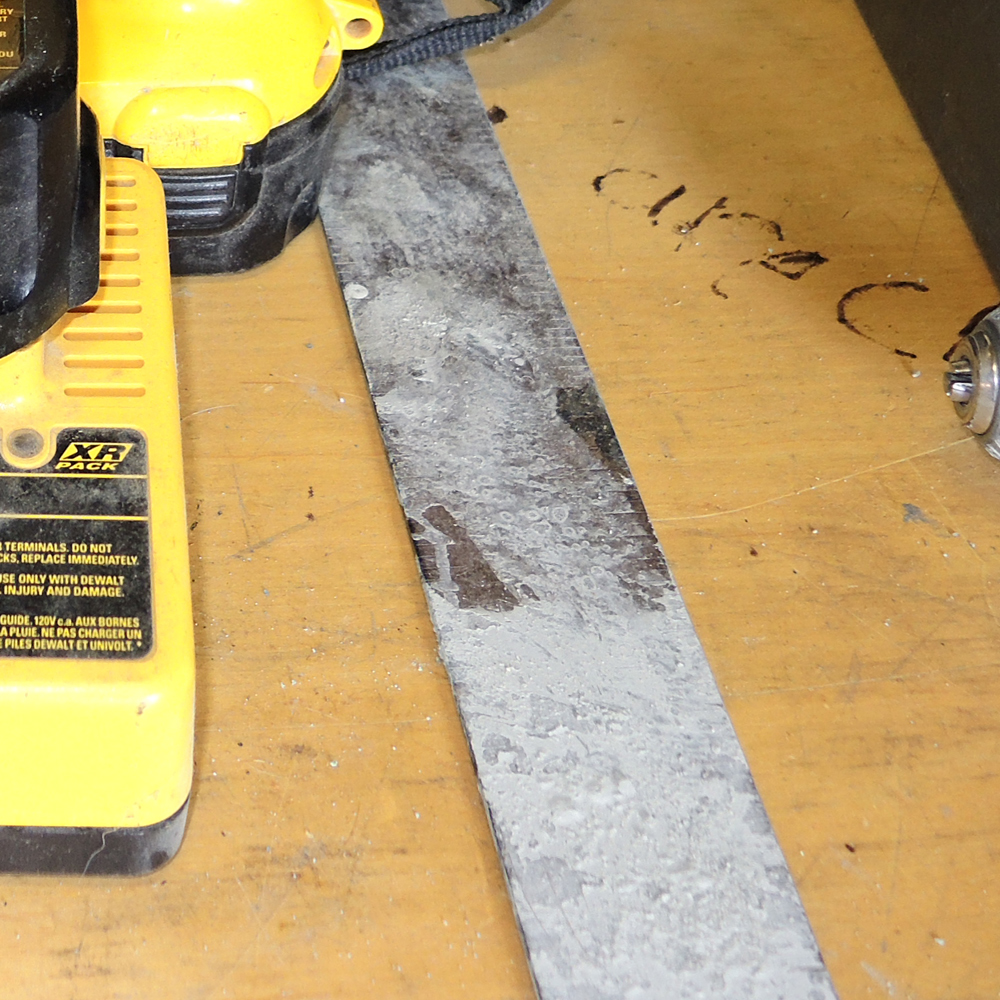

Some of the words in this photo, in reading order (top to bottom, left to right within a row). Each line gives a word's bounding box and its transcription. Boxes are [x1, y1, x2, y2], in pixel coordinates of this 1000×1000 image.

[63, 443, 127, 460] XR
[55, 461, 120, 471] PACK
[71, 542, 87, 553] DO
[89, 543, 112, 553] NOT
[21, 553, 66, 564] REPLACE
[18, 573, 46, 584] ONLY
[48, 574, 78, 584] WITH
[80, 574, 124, 585] DEWALT
[3, 584, 44, 595] INJURY
[46, 585, 71, 596] AND
